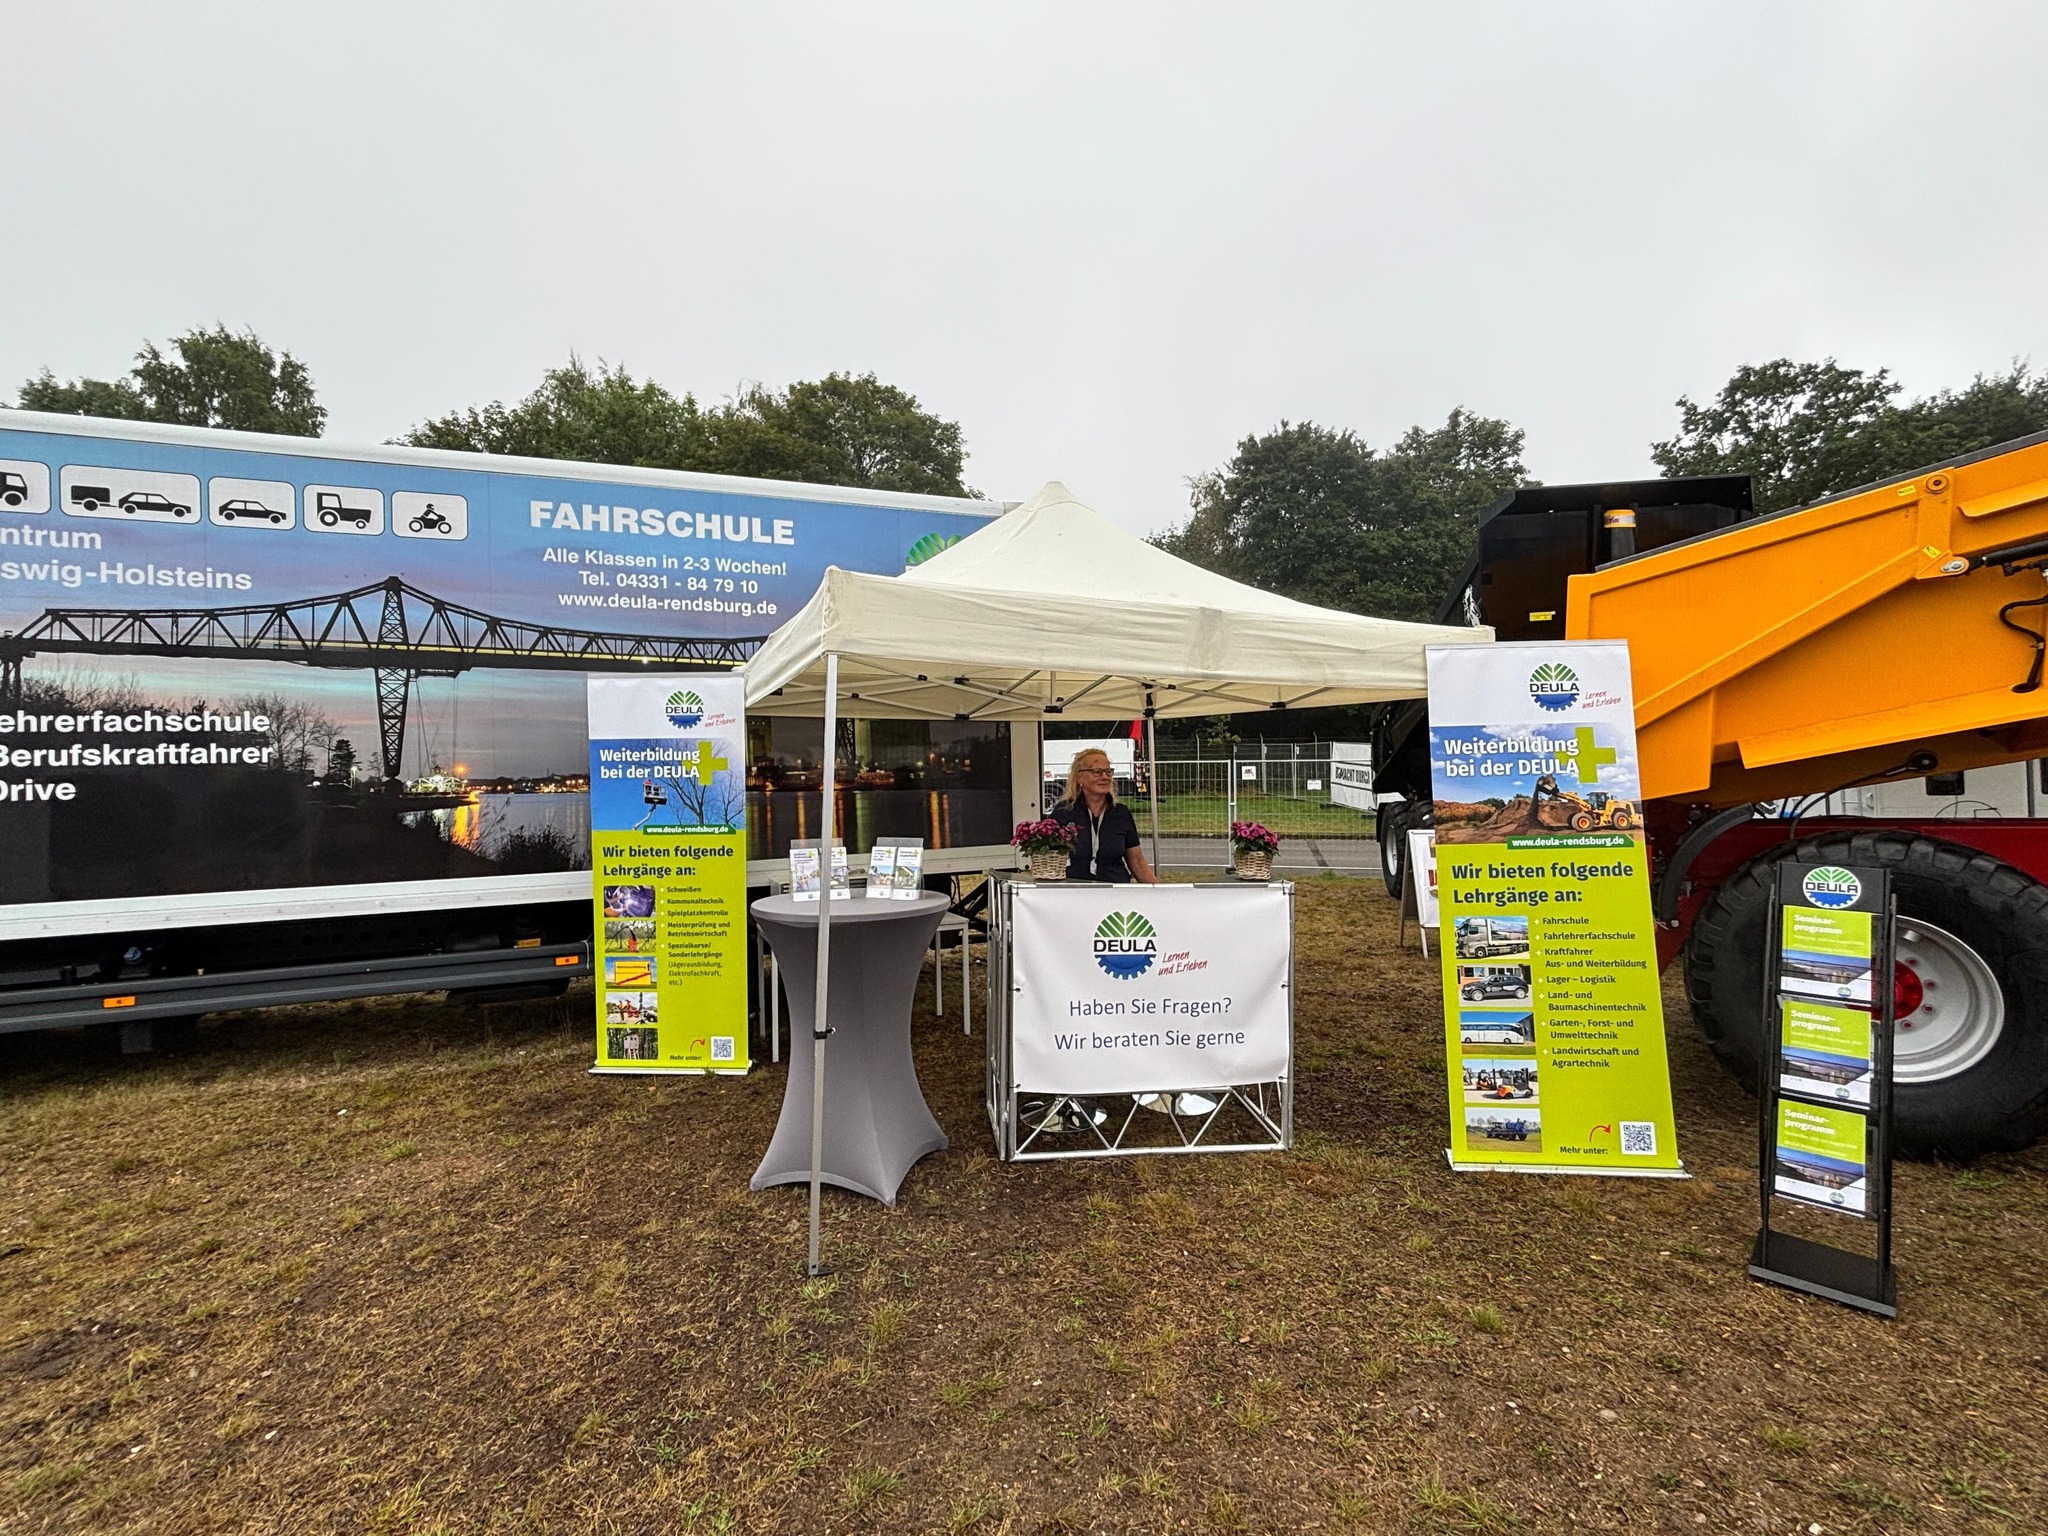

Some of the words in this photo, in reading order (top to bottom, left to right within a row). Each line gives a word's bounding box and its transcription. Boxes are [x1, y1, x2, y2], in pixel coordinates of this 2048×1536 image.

[530, 500, 795, 545] FAHRSCHULE
[0, 525, 101, 549] ntrum
[543, 547, 579, 564] Alle
[585, 550, 657, 568] Klassen
[663, 554, 678, 569] in
[683, 557, 710, 571] 2-3
[715, 558, 787, 576] Wochen!
[1, 559, 253, 590] swig-Holsteins
[579, 571, 610, 586] Tel.
[616, 573, 668, 589] 04331
[687, 577, 708, 591] 84
[714, 578, 734, 593] 79
[740, 579, 758, 594] 10
[558, 593, 778, 617] www.deula-rendsburg.de
[1530, 682, 1580, 692] DEULA
[1585, 690, 1607, 700] Lernen
[1582, 701, 1594, 709] und
[1595, 697, 1622, 707] Erleben
[666, 706, 704, 714] DEULA
[0, 709, 271, 733] ehrerfachschule
[1444, 736, 1580, 756] Weiterbildung
[599, 748, 701, 764] Weiterbildung
[600, 765, 623, 779] bei
[626, 765, 650, 779] der
[654, 766, 700, 778] DEULA
[1446, 759, 1475, 777] bei
[1480, 759, 1514, 776] der
[1518, 758, 1580, 775] DEULA
[646, 826, 729, 834] www.deula-rendsburg.de
[1512, 835, 1625, 848] www.deula-rendsburg.de
[602, 846, 625, 858] Wir
[629, 845, 670, 858] bieten
[674, 845, 734, 860] folgende
[603, 863, 672, 878] Lehrgänge
[676, 866, 696, 876] an:
[1451, 863, 1482, 879] Wir
[1488, 862, 1545, 879] bieten
[1551, 861, 1634, 882] folgende
[1805, 882, 1858, 894] DEULA
[1453, 886, 1548, 906] Lehrgänge
[1554, 890, 1583, 902] an:
[1542, 916, 1590, 926] Fahrschule
[1793, 914, 1836, 925] Seminar-
[1793, 923, 1843, 935] programm
[1544, 932, 1636, 940] Fahrlehrerfachschule
[1094, 940, 1157, 952] DEULA
[1544, 948, 1594, 956] Kraftfahrer
[1162, 950, 1190, 963] Lernen
[1158, 964, 1174, 976] und
[1176, 960, 1208, 973] Erleben
[1545, 960, 1564, 968] Aus-
[1566, 960, 1584, 968] und
[1586, 959, 1647, 970] Weiterbildung
[1546, 976, 1570, 986] Lager
[1580, 974, 1616, 985] Logistik
[1547, 991, 1572, 1000] Land-
[1575, 991, 1592, 1000] und
[1070, 998, 1125, 1016] Haben
[1132, 998, 1156, 1015] Sie
[1162, 998, 1232, 1018] Fragen?
[1548, 1002, 1646, 1012] Baumaschinentechnik
[1790, 1009, 1835, 1022] Seminar-
[1550, 1018, 1586, 1028] Garten-,
[1588, 1018, 1614, 1028] Forst-
[1616, 1019, 1634, 1028] und
[1790, 1020, 1841, 1033] programm
[1054, 1033, 1086, 1050] Wir
[1092, 1031, 1160, 1049] beraten
[1165, 1030, 1190, 1046] Sie
[1196, 1032, 1245, 1048] gerne
[1550, 1030, 1618, 1040] Umwelttechnik
[1552, 1046, 1620, 1056] Landwirtschaft
[1622, 1046, 1639, 1056] und
[1552, 1058, 1610, 1068] Agrartechnik
[1784, 1108, 1830, 1125] Seminar-
[1784, 1119, 1836, 1136] programm
[1560, 1146, 1581, 1154] Mehr
[1583, 1146, 1608, 1155] unter:
